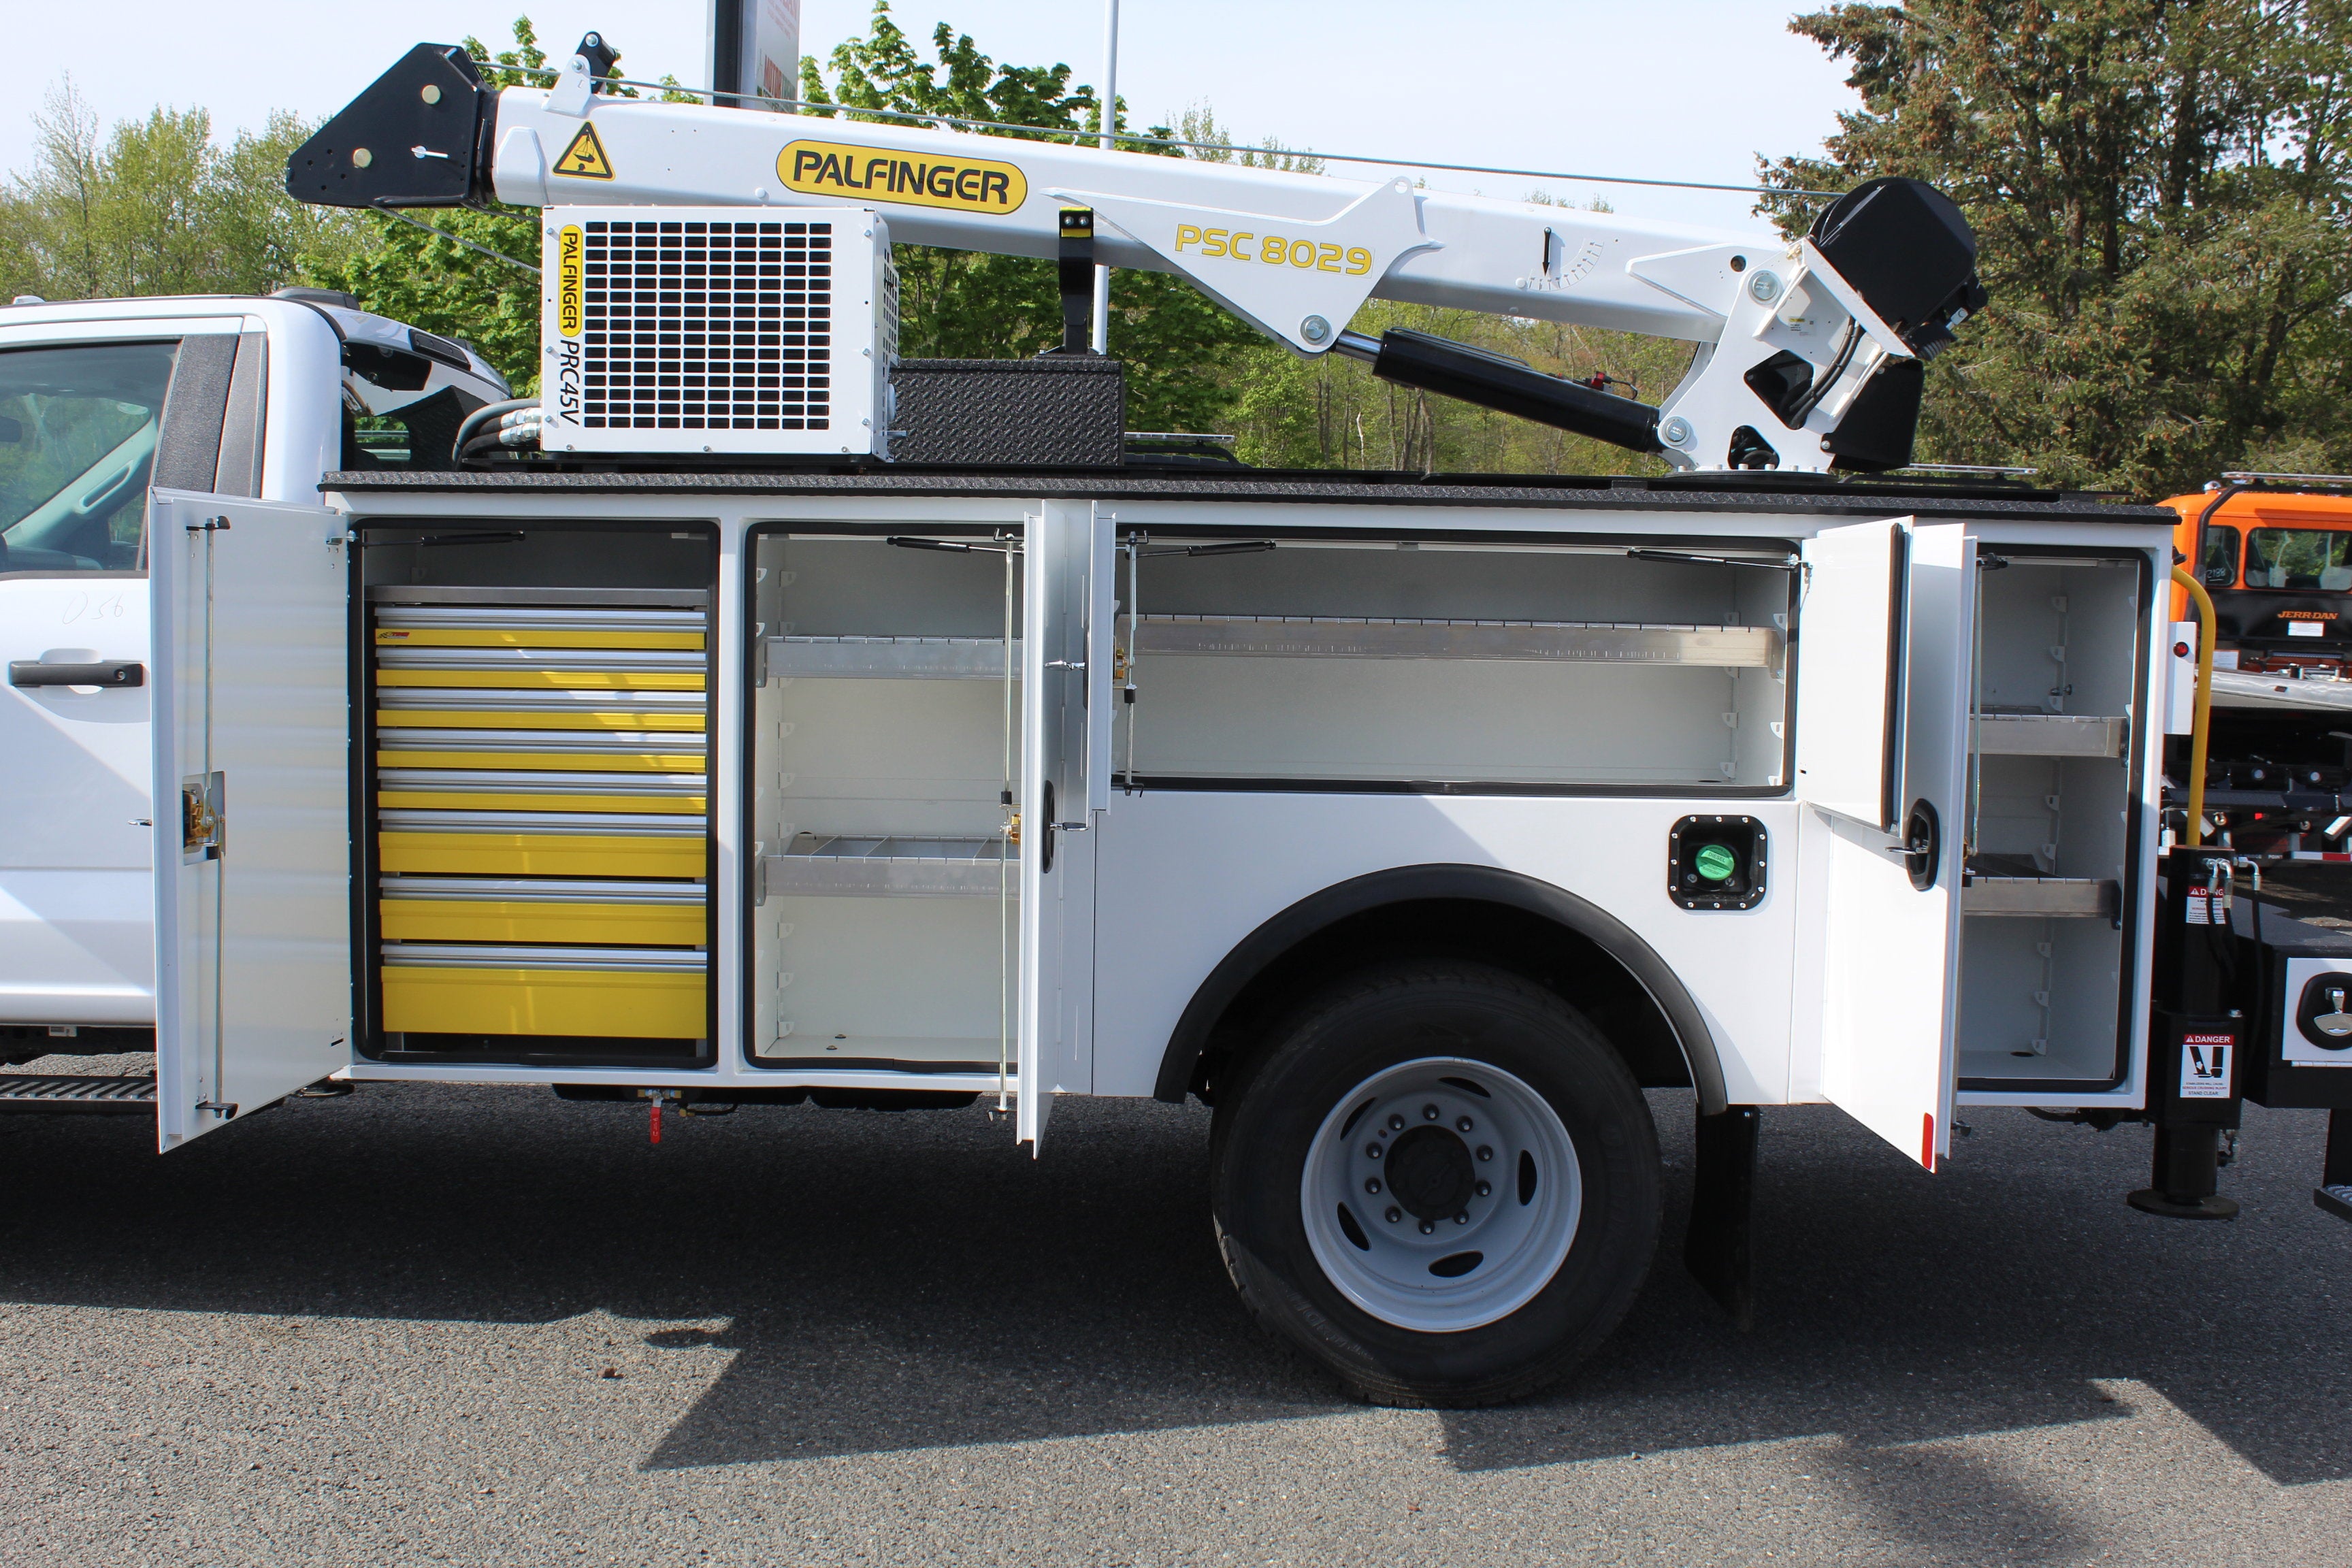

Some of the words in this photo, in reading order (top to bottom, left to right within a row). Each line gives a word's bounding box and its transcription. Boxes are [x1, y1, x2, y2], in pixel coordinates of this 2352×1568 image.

[794, 150, 1009, 204] PALFINGER
[1175, 223, 1254, 261] PSC
[1260, 235, 1372, 275] 8029
[562, 232, 578, 329] PALFINGER
[559, 339, 580, 426] PRC45V
[1708, 851, 1726, 863] DIESEL
